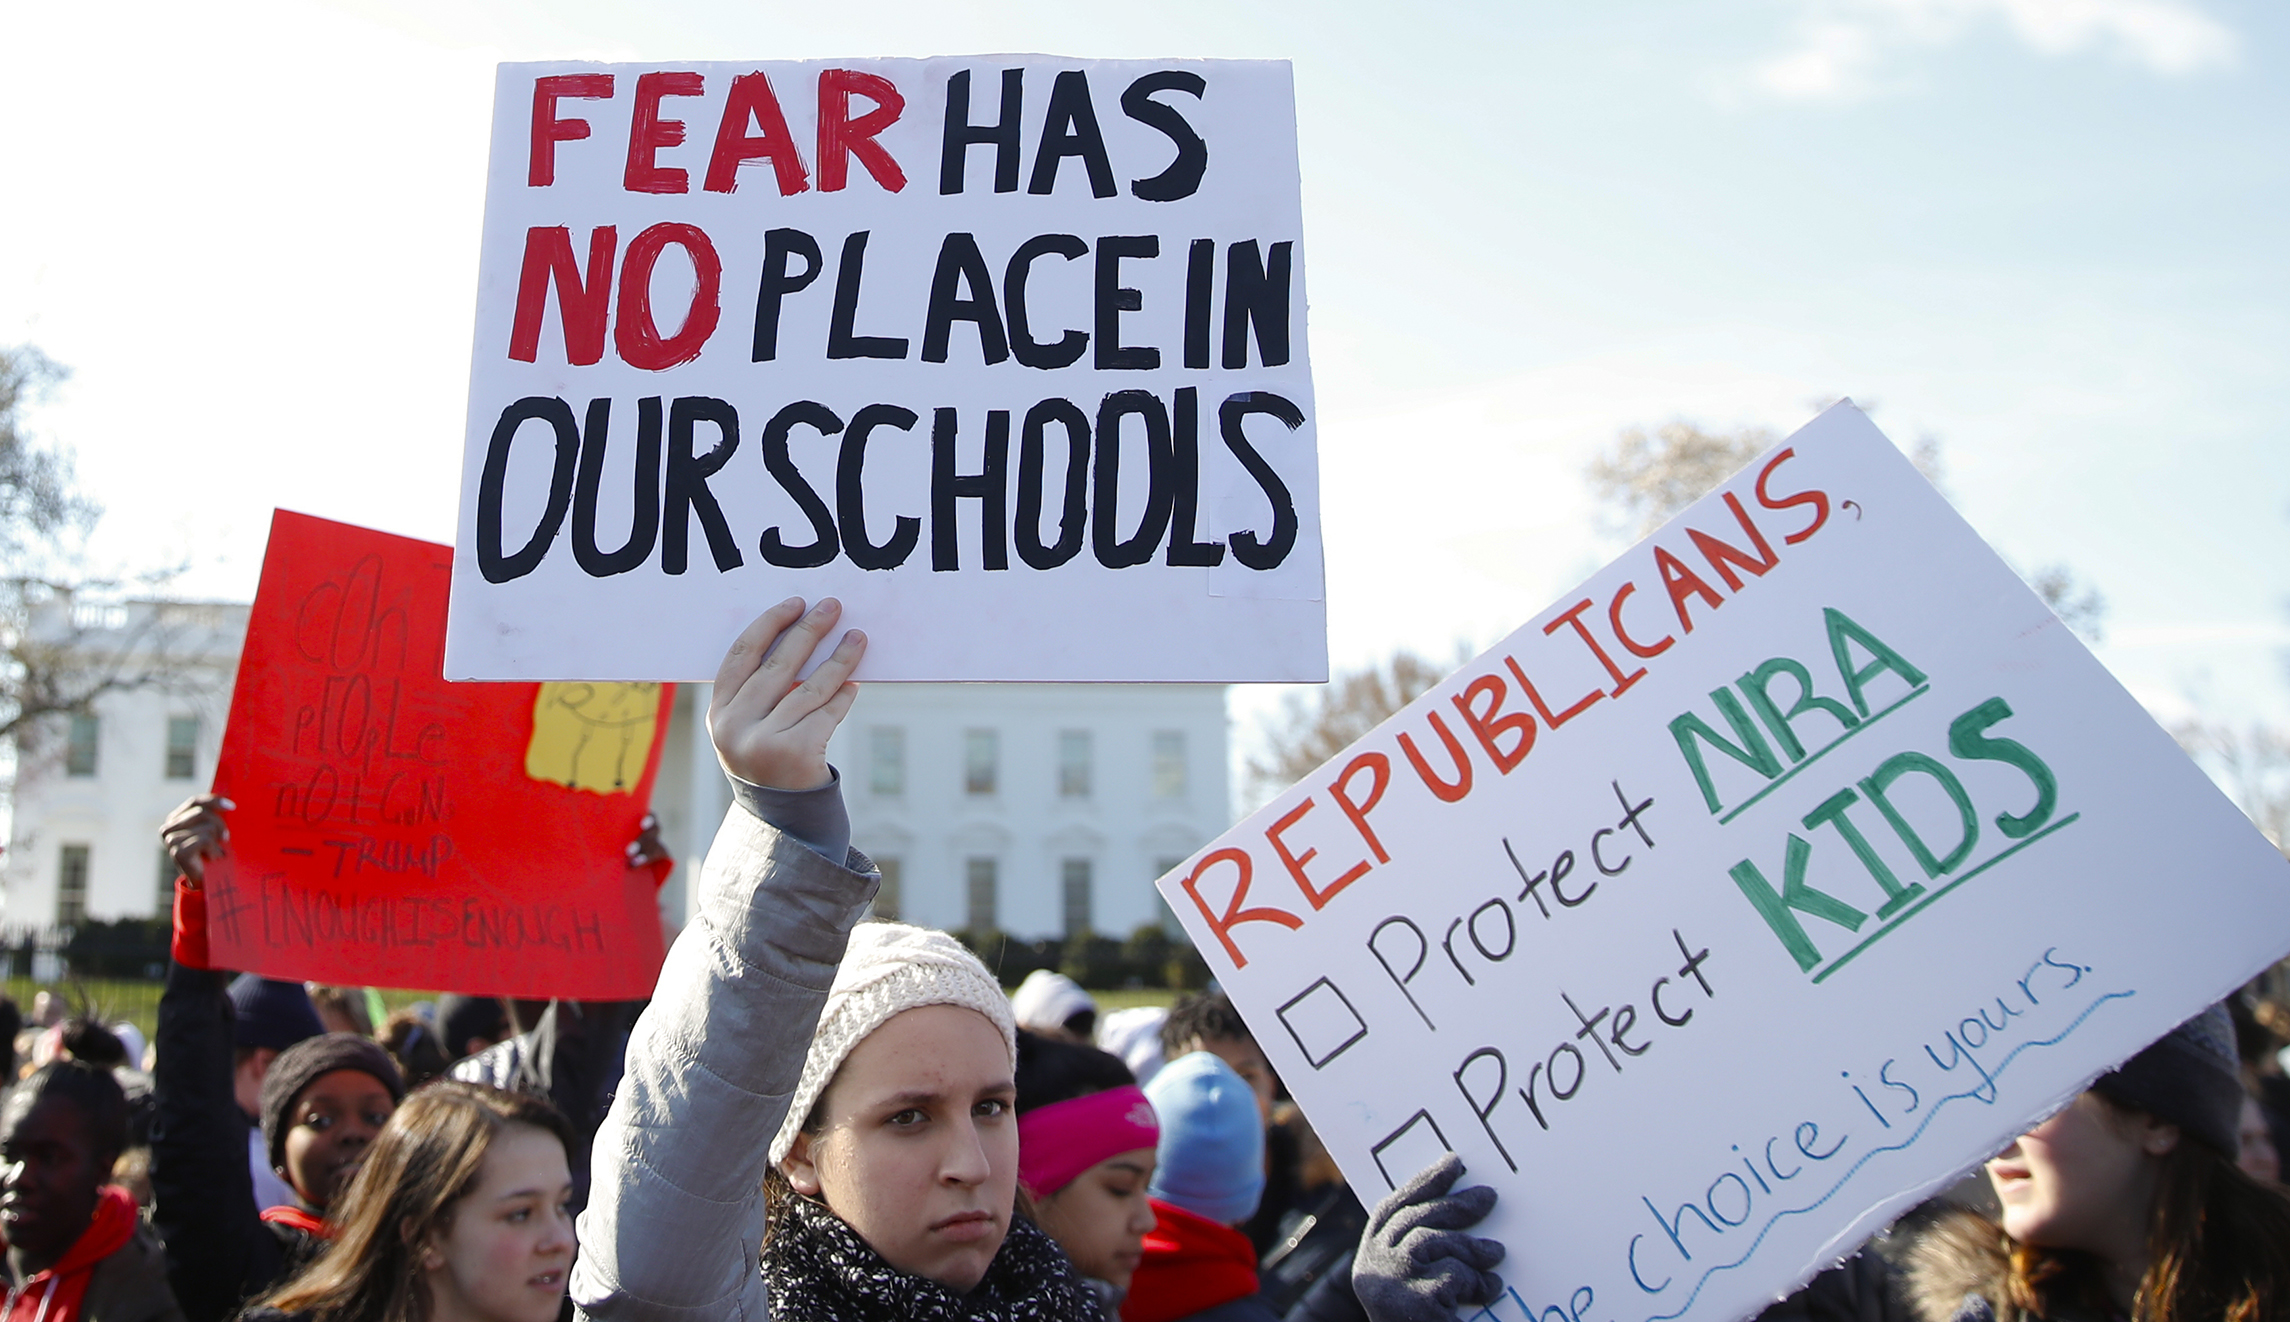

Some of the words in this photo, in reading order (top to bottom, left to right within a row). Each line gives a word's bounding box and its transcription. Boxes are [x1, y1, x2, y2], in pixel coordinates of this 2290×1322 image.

[508, 223, 721, 370] NO
[751, 228, 1161, 370] PLACE
[1184, 238, 1294, 369] IN
[527, 68, 908, 196] FEAR
[939, 68, 1208, 202] HAS
[477, 395, 743, 583] OUR
[759, 387, 1304, 571] SCHOOLS
[1180, 447, 1863, 970] REPUBLICANS,
[1367, 780, 1655, 1031] Protect
[1667, 607, 1930, 816] NRA
[1453, 928, 1715, 1173] Protect
[1728, 696, 2059, 973] KIDS
[1629, 1114, 1848, 1294] choice
[1841, 1058, 1919, 1128] is
[1925, 947, 2092, 1104] yours.
